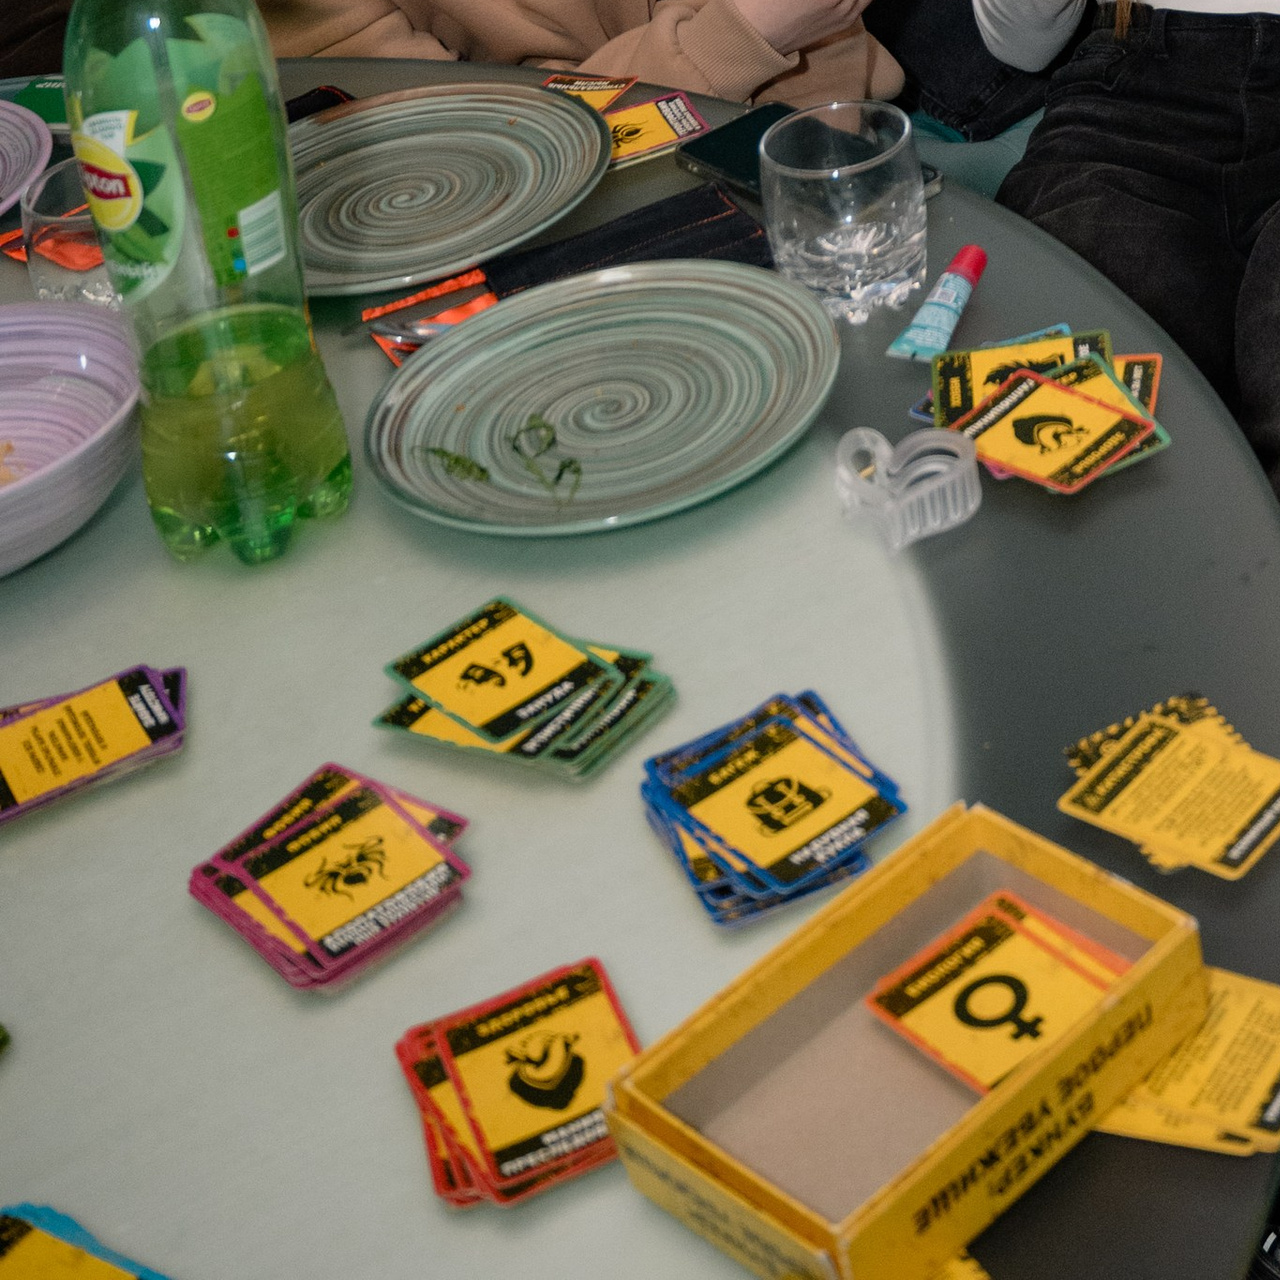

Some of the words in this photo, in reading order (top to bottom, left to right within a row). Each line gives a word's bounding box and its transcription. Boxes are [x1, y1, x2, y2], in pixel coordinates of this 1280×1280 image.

[421, 617, 489, 665] ХАРАКТЕР
[476, 984, 571, 1038] ЗДОРОВЬЕ
[1056, 1002, 1153, 1105] ПЕРВОЕ
[911, 1096, 1052, 1237] УБЕЖИЩЕ
